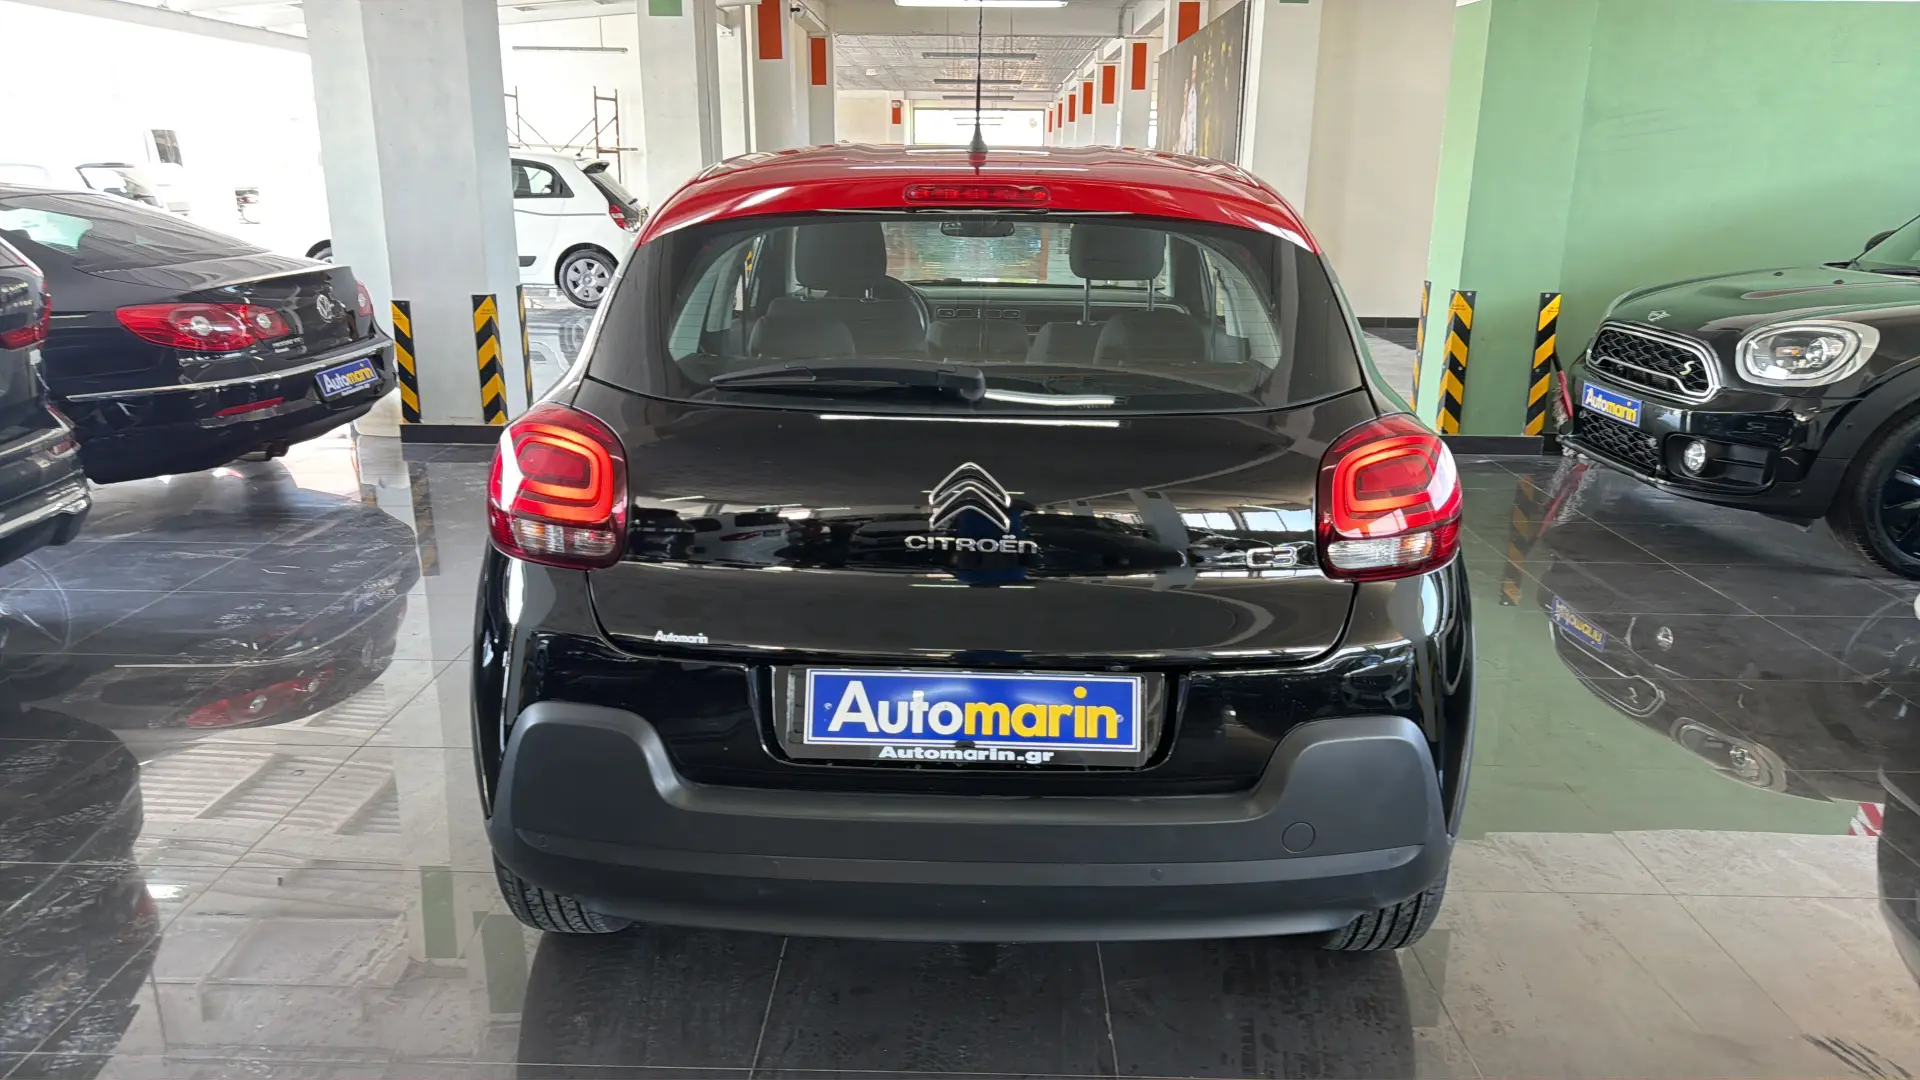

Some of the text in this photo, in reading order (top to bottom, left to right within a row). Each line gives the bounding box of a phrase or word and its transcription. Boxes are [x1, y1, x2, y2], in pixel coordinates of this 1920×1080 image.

[322, 363, 374, 393] Automarin
[1585, 387, 1638, 423] Automarin
[1246, 546, 1298, 569] C3
[653, 630, 709, 644] Automarin
[827, 680, 1119, 739] Automarin
[878, 746, 1055, 764] Automarin.gr
